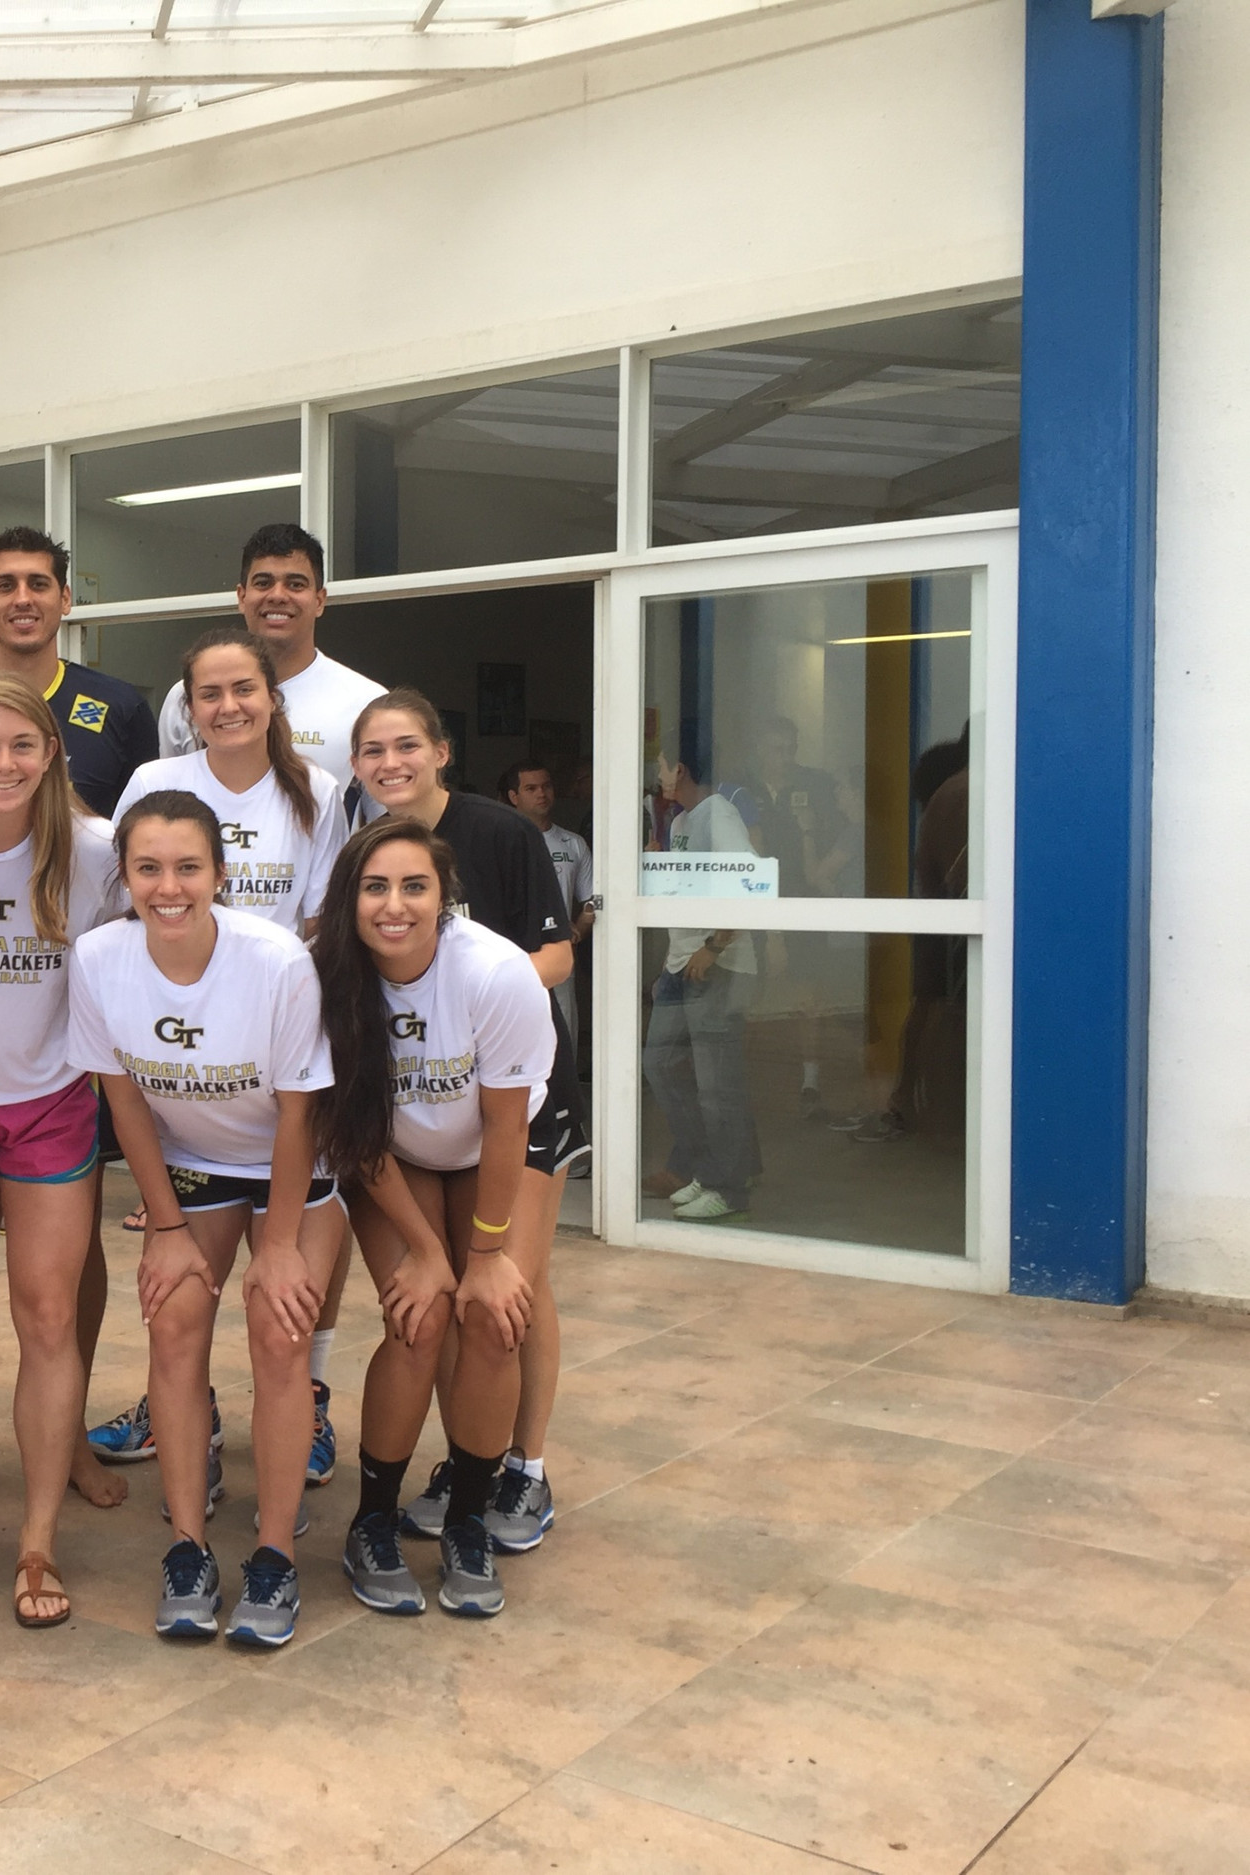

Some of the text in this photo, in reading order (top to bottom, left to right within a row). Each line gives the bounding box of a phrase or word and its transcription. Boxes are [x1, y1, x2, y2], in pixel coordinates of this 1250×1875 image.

[219, 823, 258, 849] GT
[551, 852, 574, 862] SIL
[695, 862, 756, 873] FECHADO
[235, 880, 293, 894] JACKETS
[154, 1016, 204, 1050] GT
[390, 1011, 427, 1042] GT
[182, 1076, 261, 1094] JACKETS
